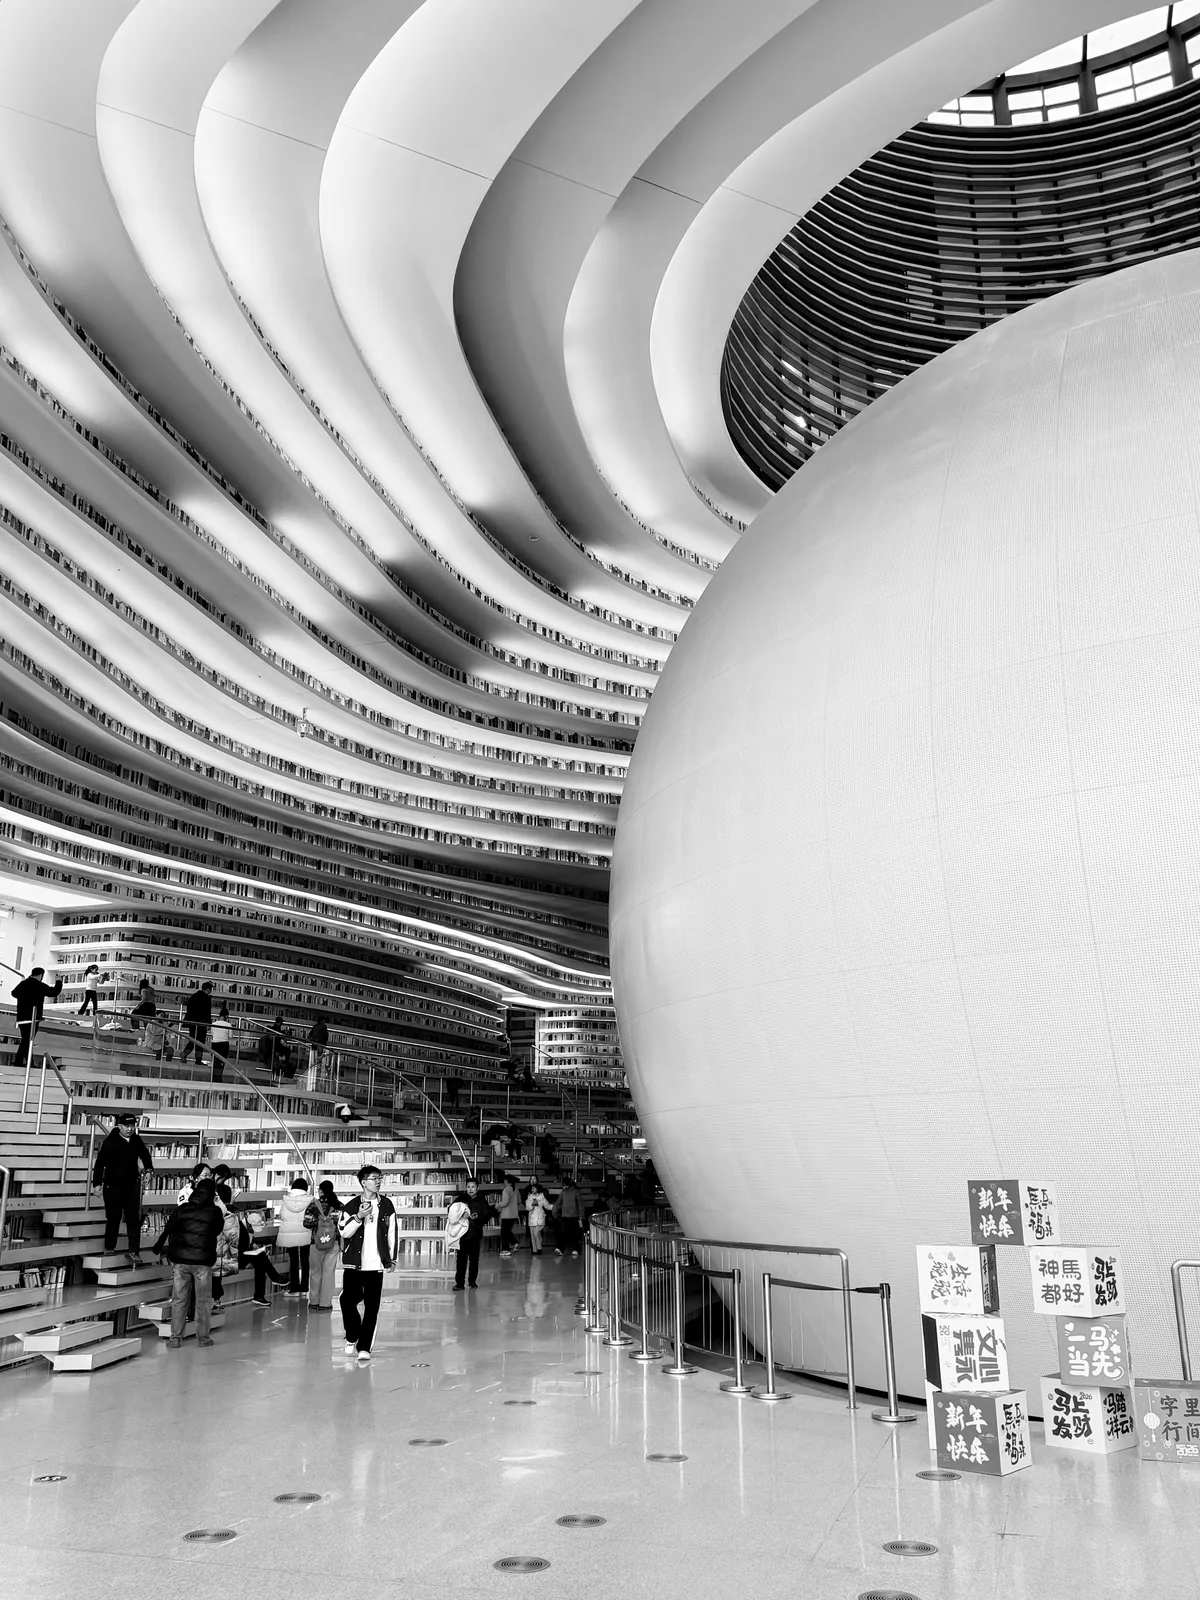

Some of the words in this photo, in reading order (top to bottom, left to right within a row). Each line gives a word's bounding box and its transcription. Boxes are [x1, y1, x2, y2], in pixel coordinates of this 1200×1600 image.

[978, 1187, 1013, 1211] 新年
[979, 1214, 1014, 1238] 快乐
[950, 1263, 972, 1297] 生活
[1038, 1259, 1082, 1280] 神馬
[1094, 1256, 1116, 1282] 马上
[1041, 1283, 1084, 1305] 都好
[1094, 1278, 1118, 1306] 发财
[1067, 1326, 1109, 1352] 一马
[976, 1329, 1000, 1383] 文心
[1068, 1350, 1121, 1378] 当先
[1052, 1388, 1090, 1416] 马上
[1160, 1395, 1200, 1417] 字里
[945, 1401, 988, 1433] 新年
[1052, 1414, 1093, 1439] 发财
[1105, 1414, 1130, 1439] 祥云
[1162, 1420, 1200, 1442] 行间
[946, 1434, 989, 1465] 快乐
